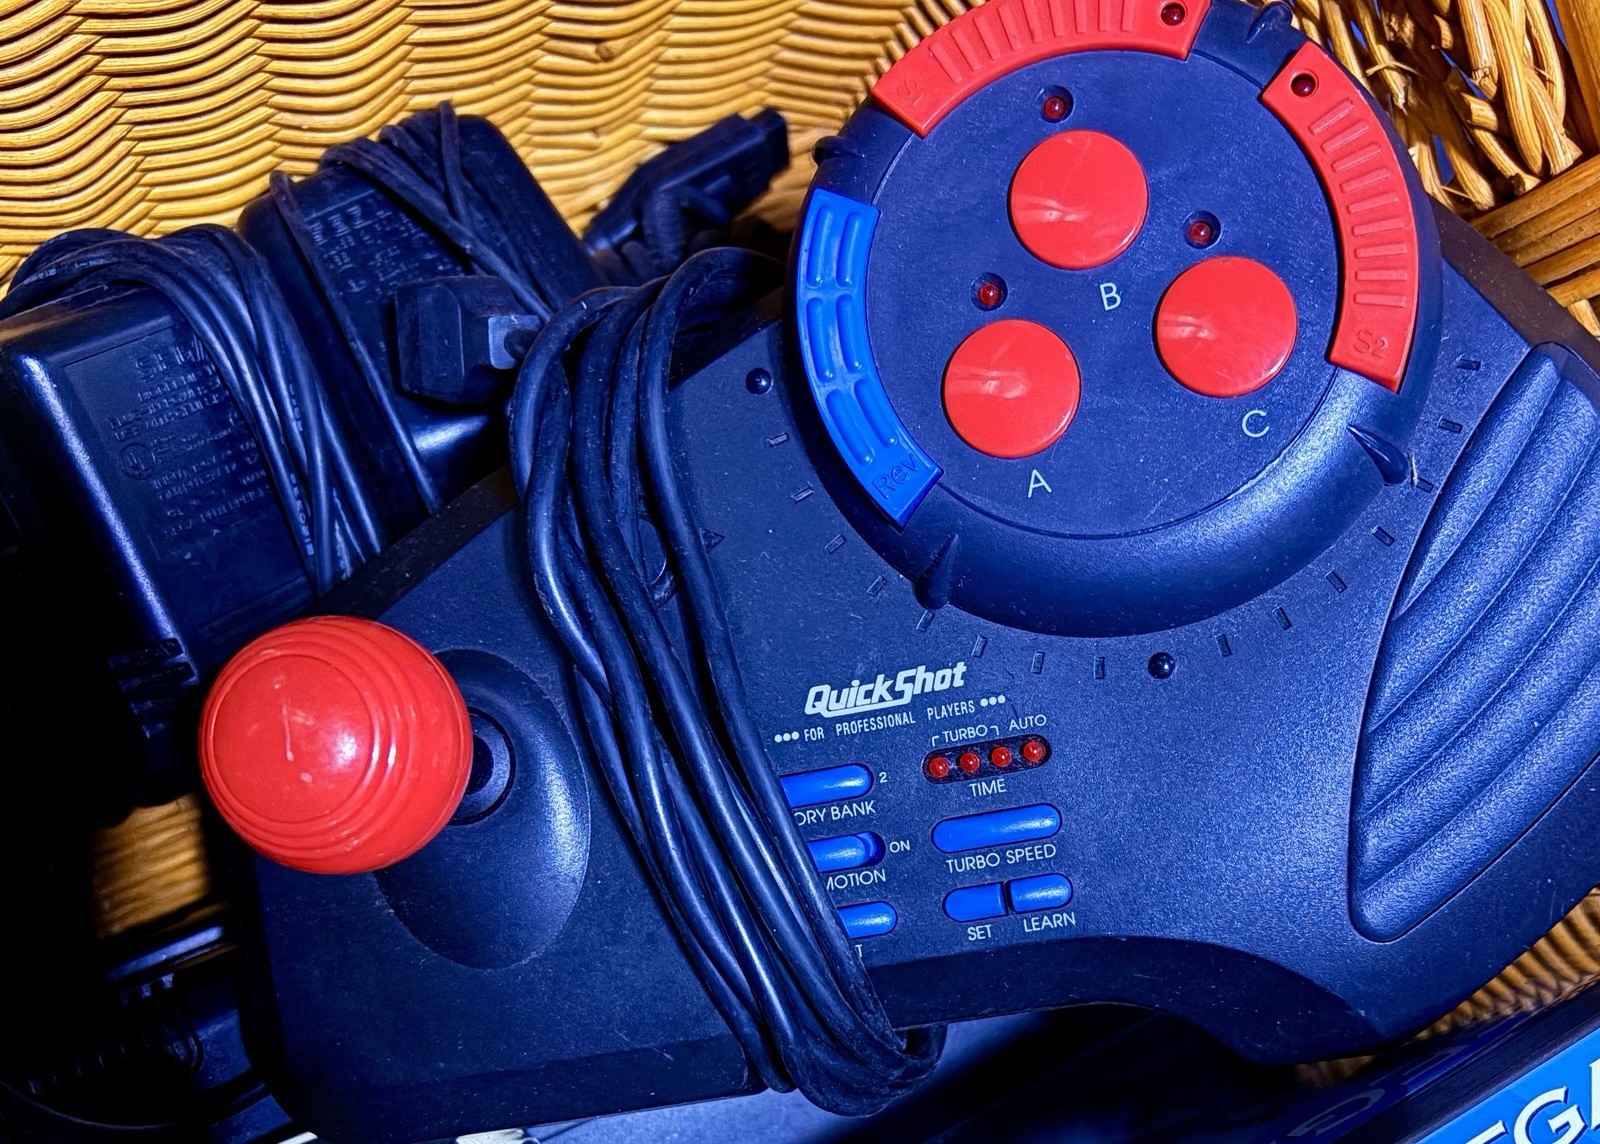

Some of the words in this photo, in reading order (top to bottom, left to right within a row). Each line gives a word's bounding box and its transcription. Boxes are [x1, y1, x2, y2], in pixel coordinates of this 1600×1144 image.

[1100, 282, 1122, 311] B
[1353, 329, 1389, 359] S2
[1242, 409, 1270, 438] C
[872, 451, 919, 500] Rev
[1027, 468, 1053, 498] A
[803, 725, 825, 742] FOR
[835, 711, 916, 737] PROFESSIONAL
[926, 699, 976, 721] PLAYERS
[942, 724, 988, 743] TURBO
[1008, 713, 1048, 733] AUTO
[879, 771, 888, 784] 2
[969, 778, 1007, 798] TIME
[830, 800, 877, 821] BANK
[889, 839, 911, 854] ON
[945, 852, 1001, 874] TURBO
[1005, 843, 1057, 865] SPEED
[966, 924, 992, 941] SET
[1023, 911, 1076, 933] LEARN
